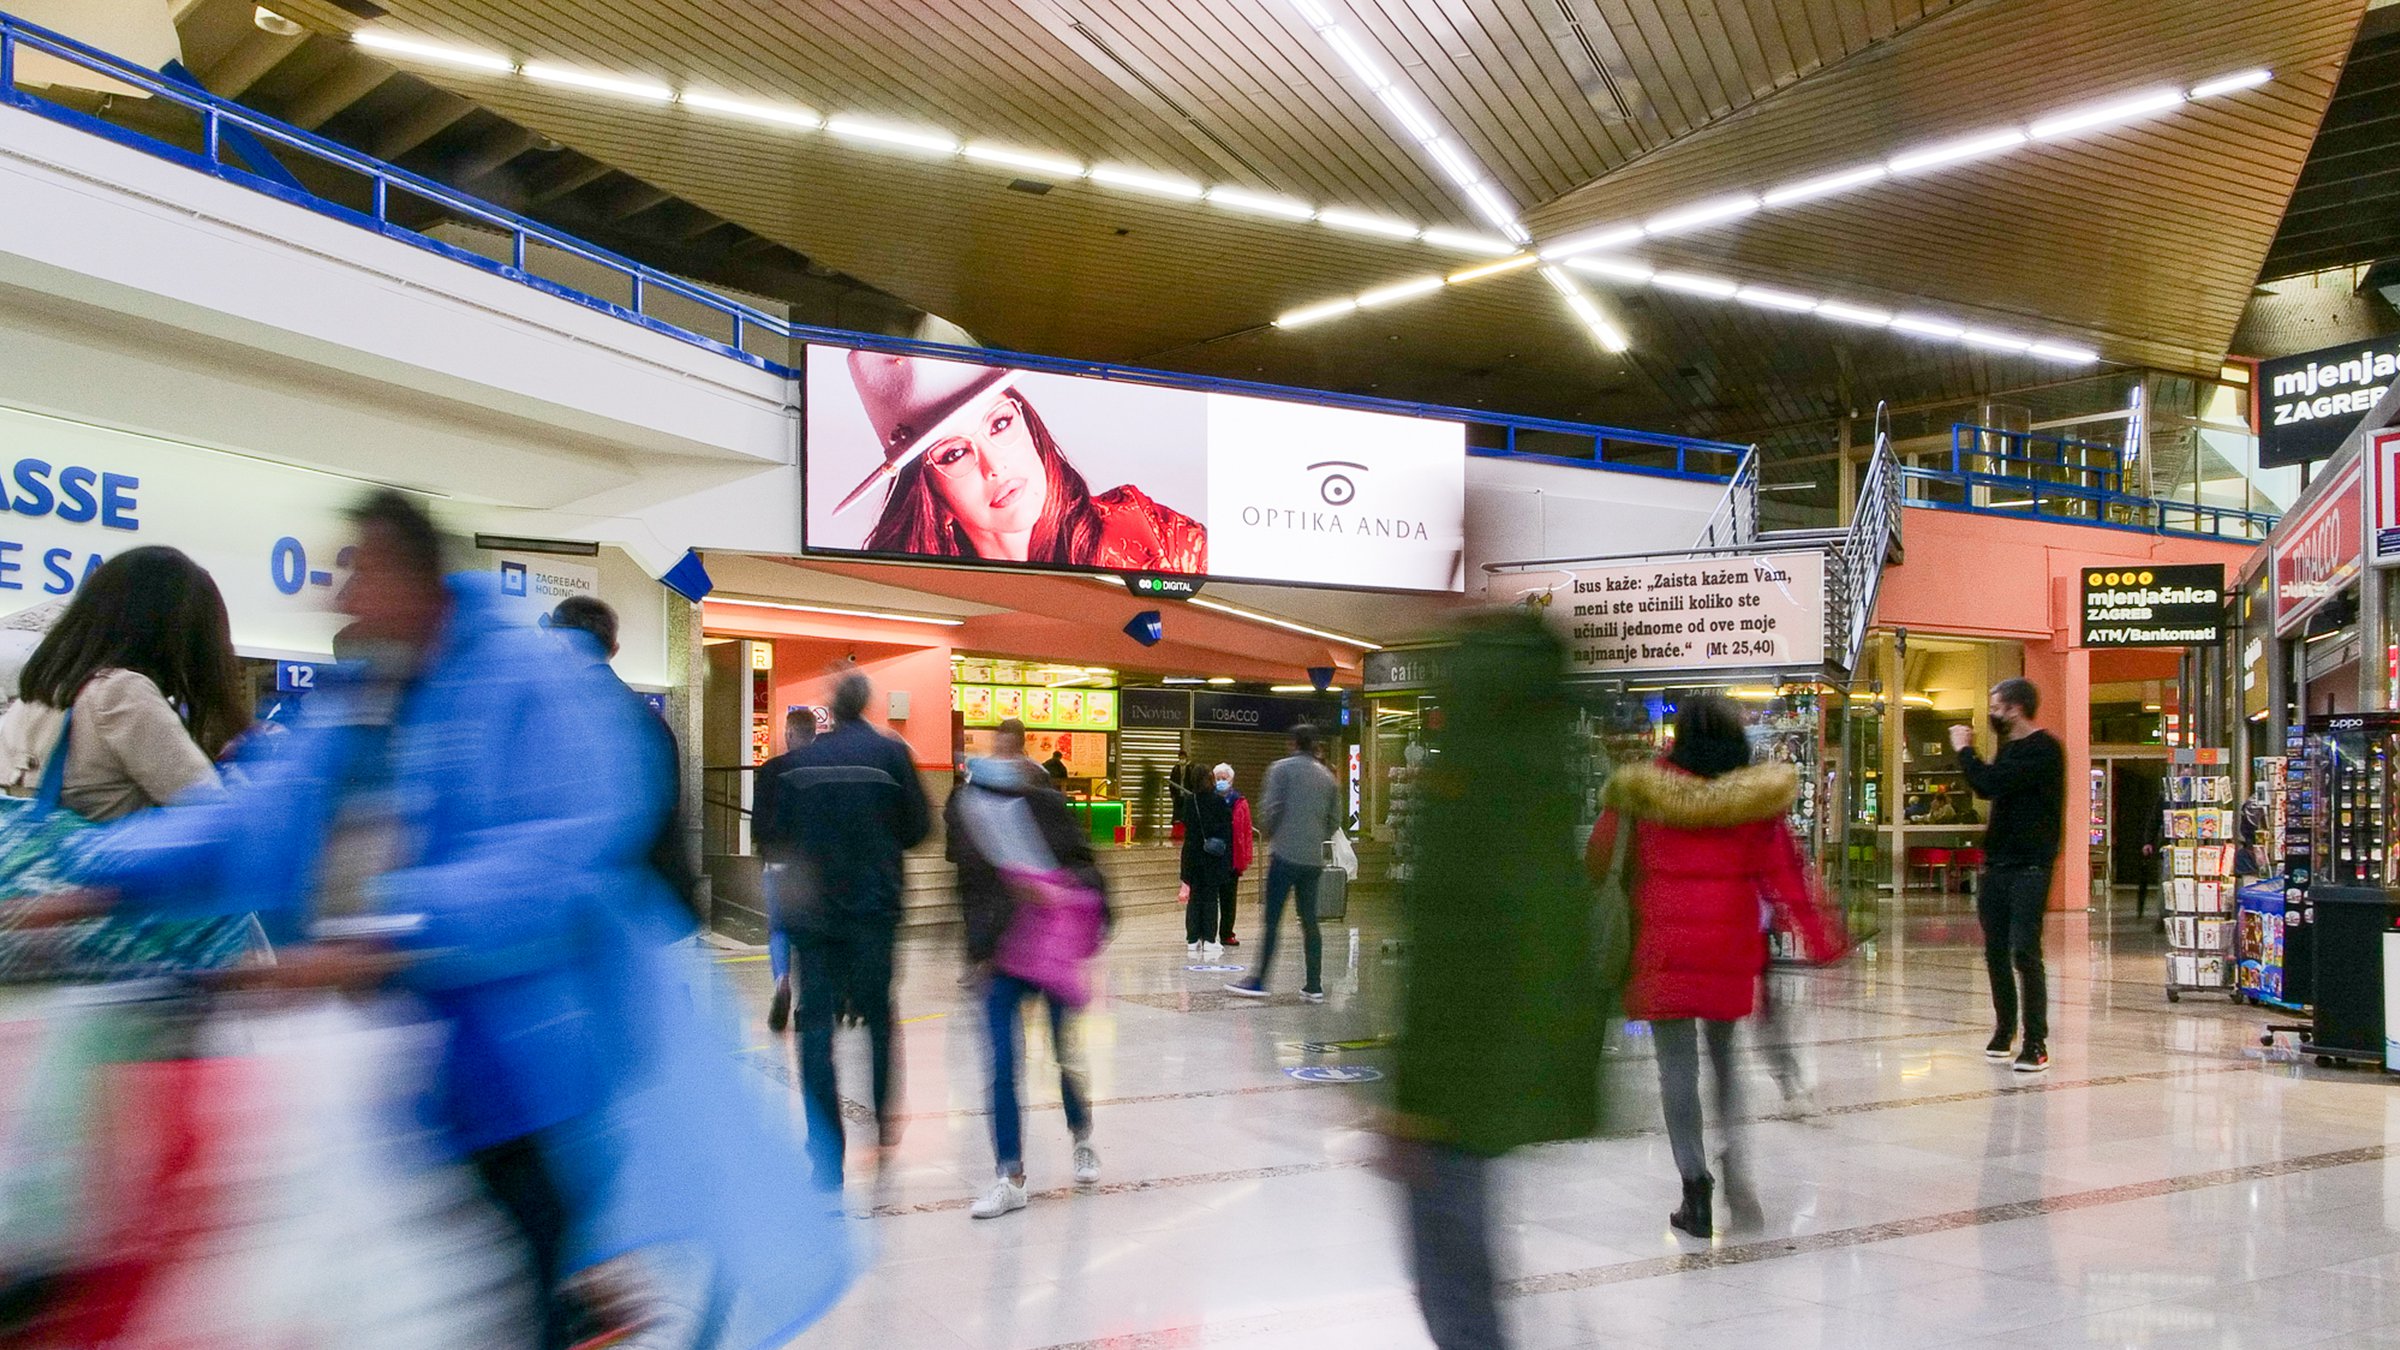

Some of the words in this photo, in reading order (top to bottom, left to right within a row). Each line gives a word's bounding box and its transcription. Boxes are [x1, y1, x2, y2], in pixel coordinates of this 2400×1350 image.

[2274, 344, 2400, 397] mjenja
[0, 458, 139, 531] SSE
[1242, 506, 1344, 534] OPTIKA
[1356, 516, 1428, 541] ANDA
[2292, 507, 2340, 586] TOBACCO
[536, 573, 590, 590] ZAGREBAČKI
[536, 585, 574, 598] HOLDING
[1573, 579, 1602, 594] Isus
[1606, 575, 1642, 592] kaže:
[1701, 569, 1749, 586] kažem
[1754, 567, 1792, 584] Vam,
[1573, 600, 1609, 617] meni
[1613, 600, 1634, 614] ste
[1638, 595, 1684, 613] učinili
[1689, 593, 1733, 610] koliko
[1738, 593, 1761, 607] ste
[2087, 586, 2218, 608] mjenjačnica
[2087, 607, 2153, 621] ZAGREB
[1573, 622, 1618, 639] učinili
[1621, 620, 1683, 641] jednome
[1687, 618, 1705, 633] od
[1709, 619, 1735, 632] ove
[1740, 614, 1776, 634] moje
[2087, 627, 2217, 644] ATM/Bankomati
[1573, 644, 1638, 665] najmanje
[1706, 641, 1728, 659] (Mt
[1731, 638, 1774, 657] 25,40)
[287, 665, 314, 688] 12
[1211, 708, 1259, 723] TOBACCO
[2328, 718, 2364, 729] zippo
